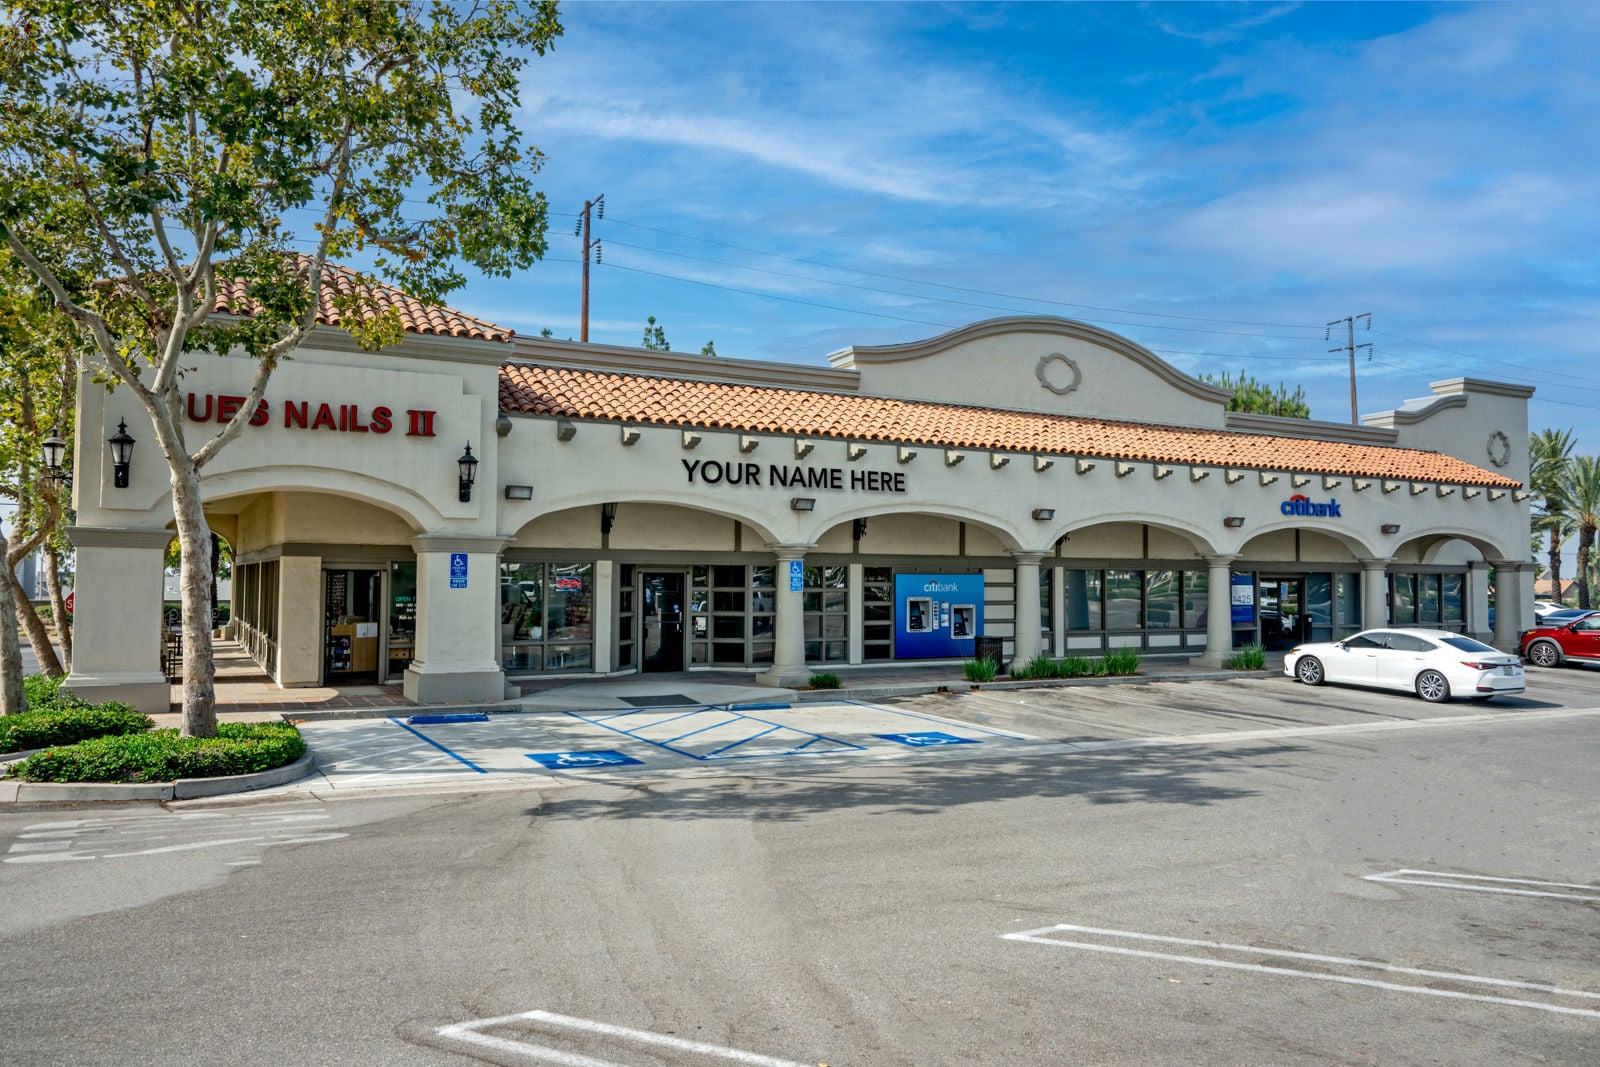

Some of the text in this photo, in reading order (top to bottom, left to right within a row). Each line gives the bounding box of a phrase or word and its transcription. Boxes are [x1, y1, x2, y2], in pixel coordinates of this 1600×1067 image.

[285, 401, 393, 433] NAILS
[405, 409, 437, 437] II
[681, 459, 906, 492] YOUR NAME HERE
[1280, 496, 1342, 517] citibank
[923, 582, 958, 592] citibank
